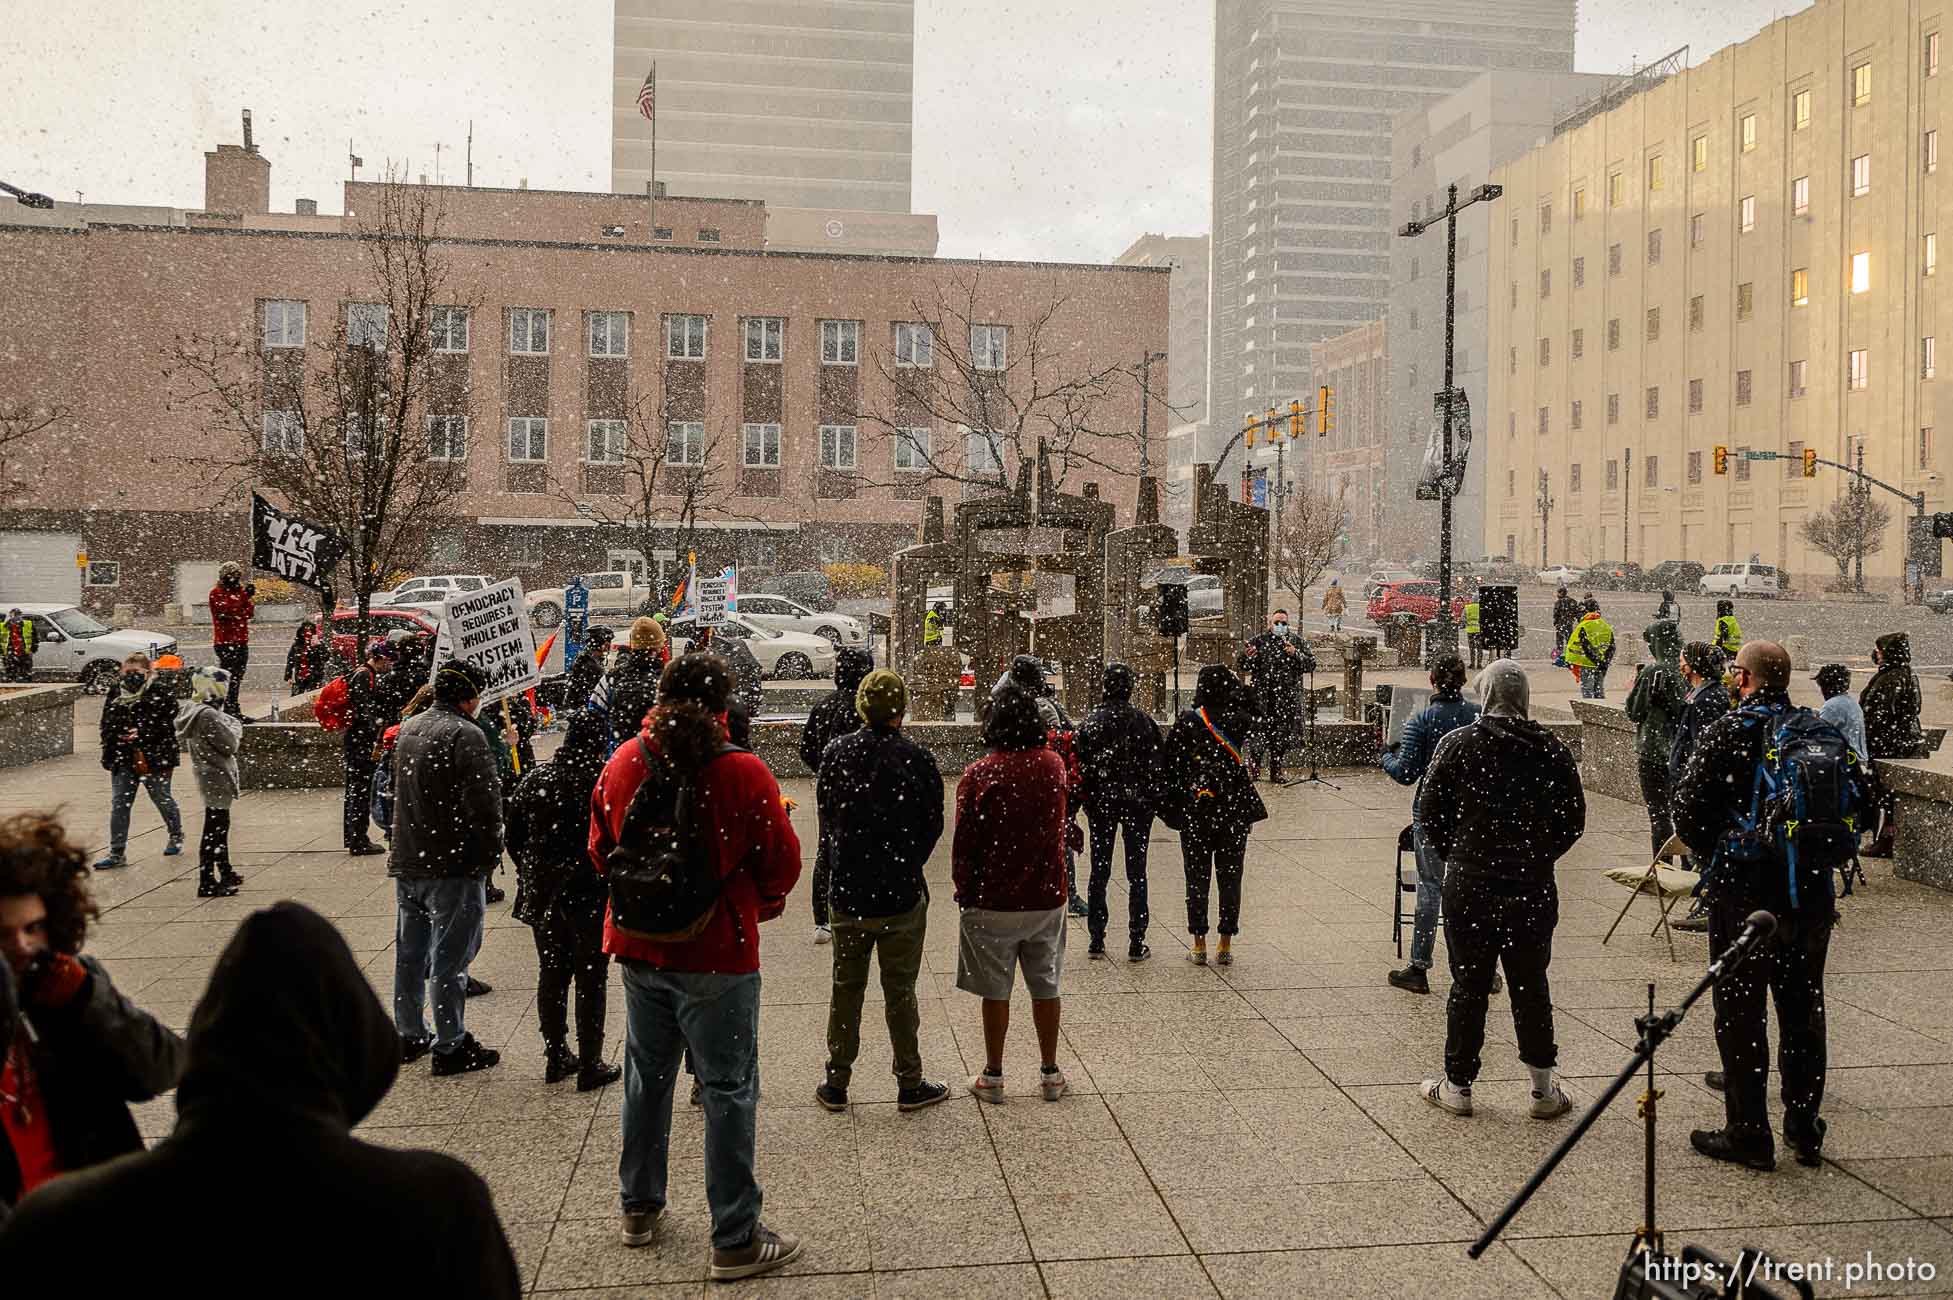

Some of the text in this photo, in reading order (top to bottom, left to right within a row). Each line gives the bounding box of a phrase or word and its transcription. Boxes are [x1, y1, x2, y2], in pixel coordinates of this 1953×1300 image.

[451, 586, 516, 619] DEMOCRACY
[461, 605, 514, 632] REQUIRES A
[461, 617, 520, 650] WHOLE NEW
[467, 638, 524, 668] SYSTEM!
